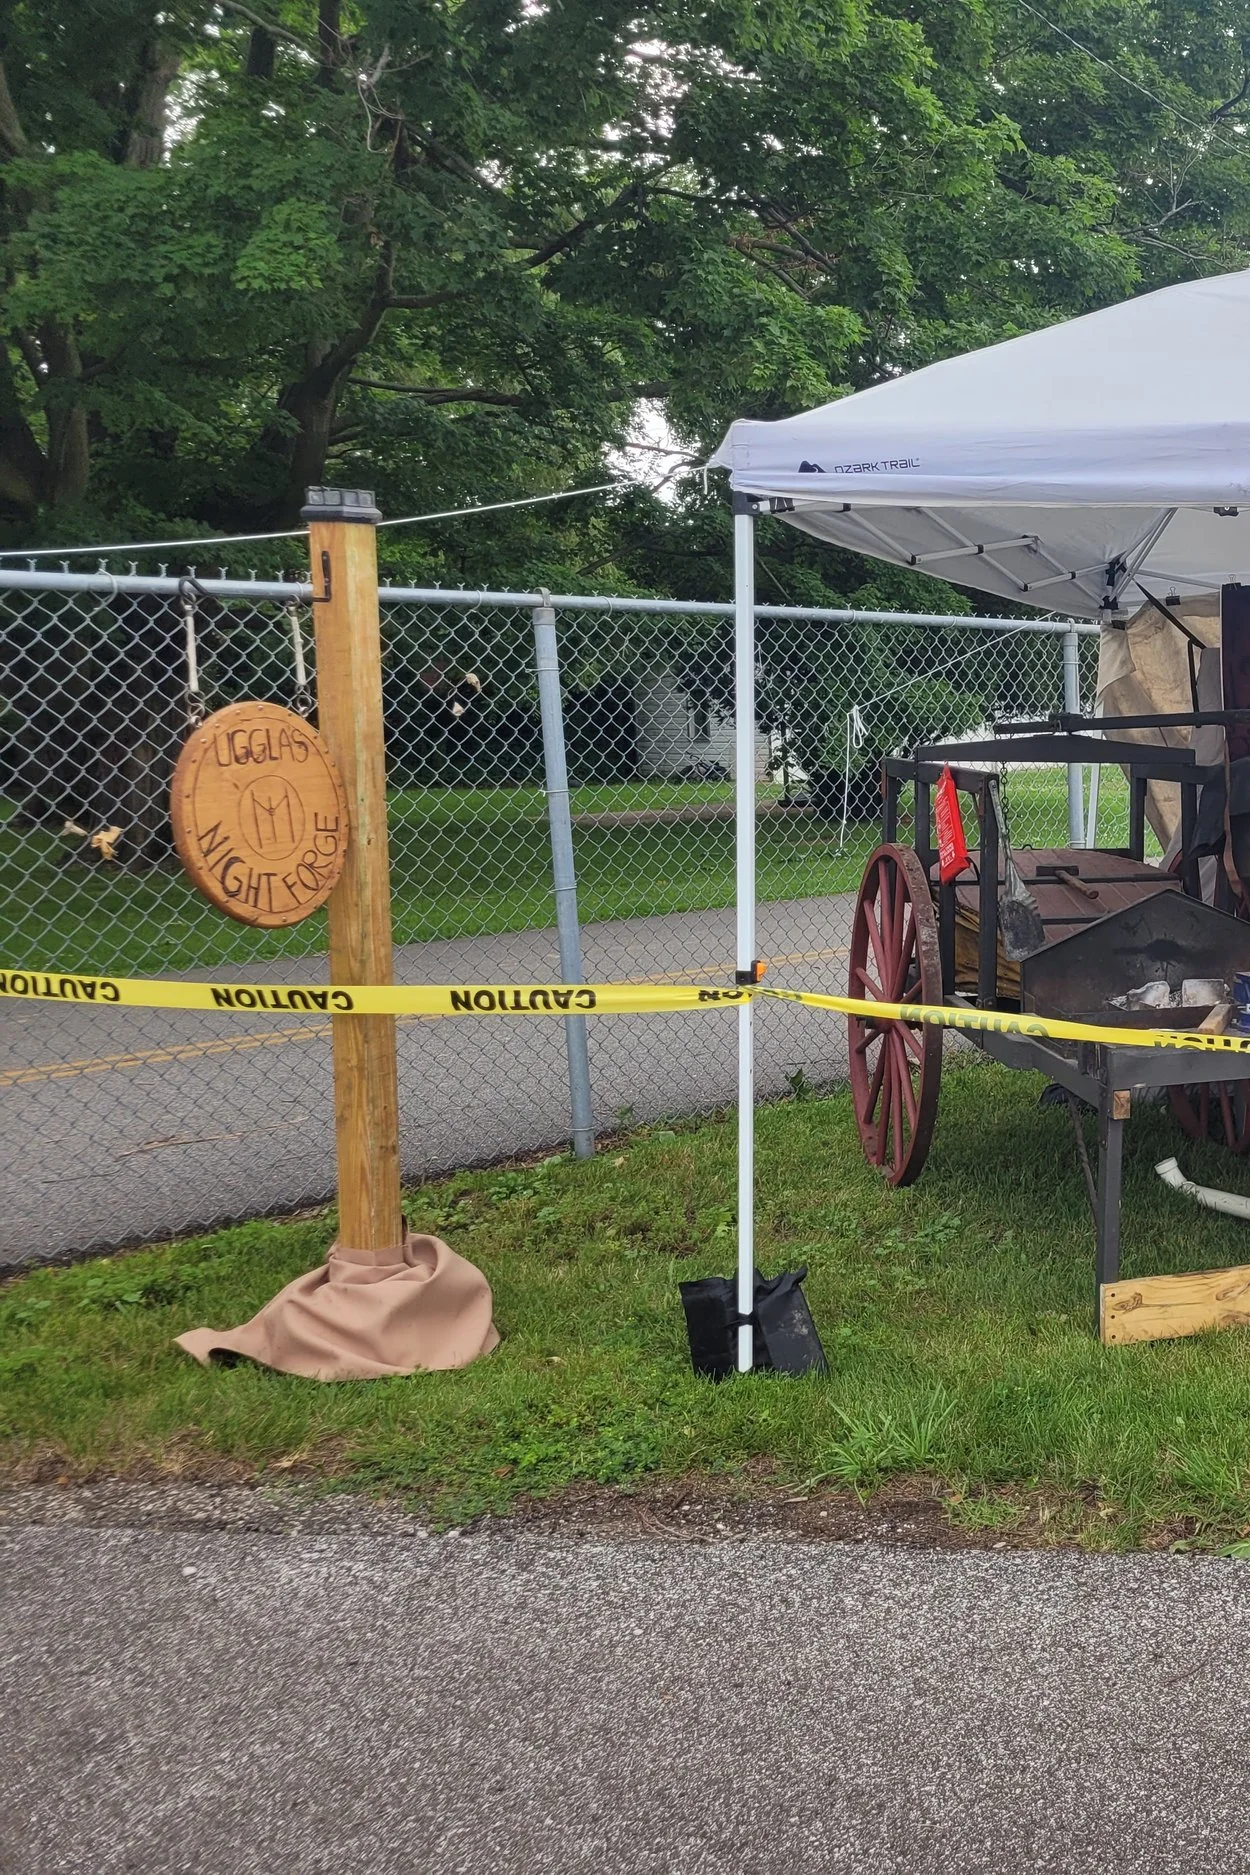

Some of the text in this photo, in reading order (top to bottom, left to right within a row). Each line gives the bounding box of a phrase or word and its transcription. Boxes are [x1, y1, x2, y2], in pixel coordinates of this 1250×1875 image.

[880, 458, 920, 471] TRAIL
[197, 812, 339, 912] NIGHT FORGE
[210, 987, 355, 1011] CAUTION
[450, 989, 597, 1012] CAUTION
